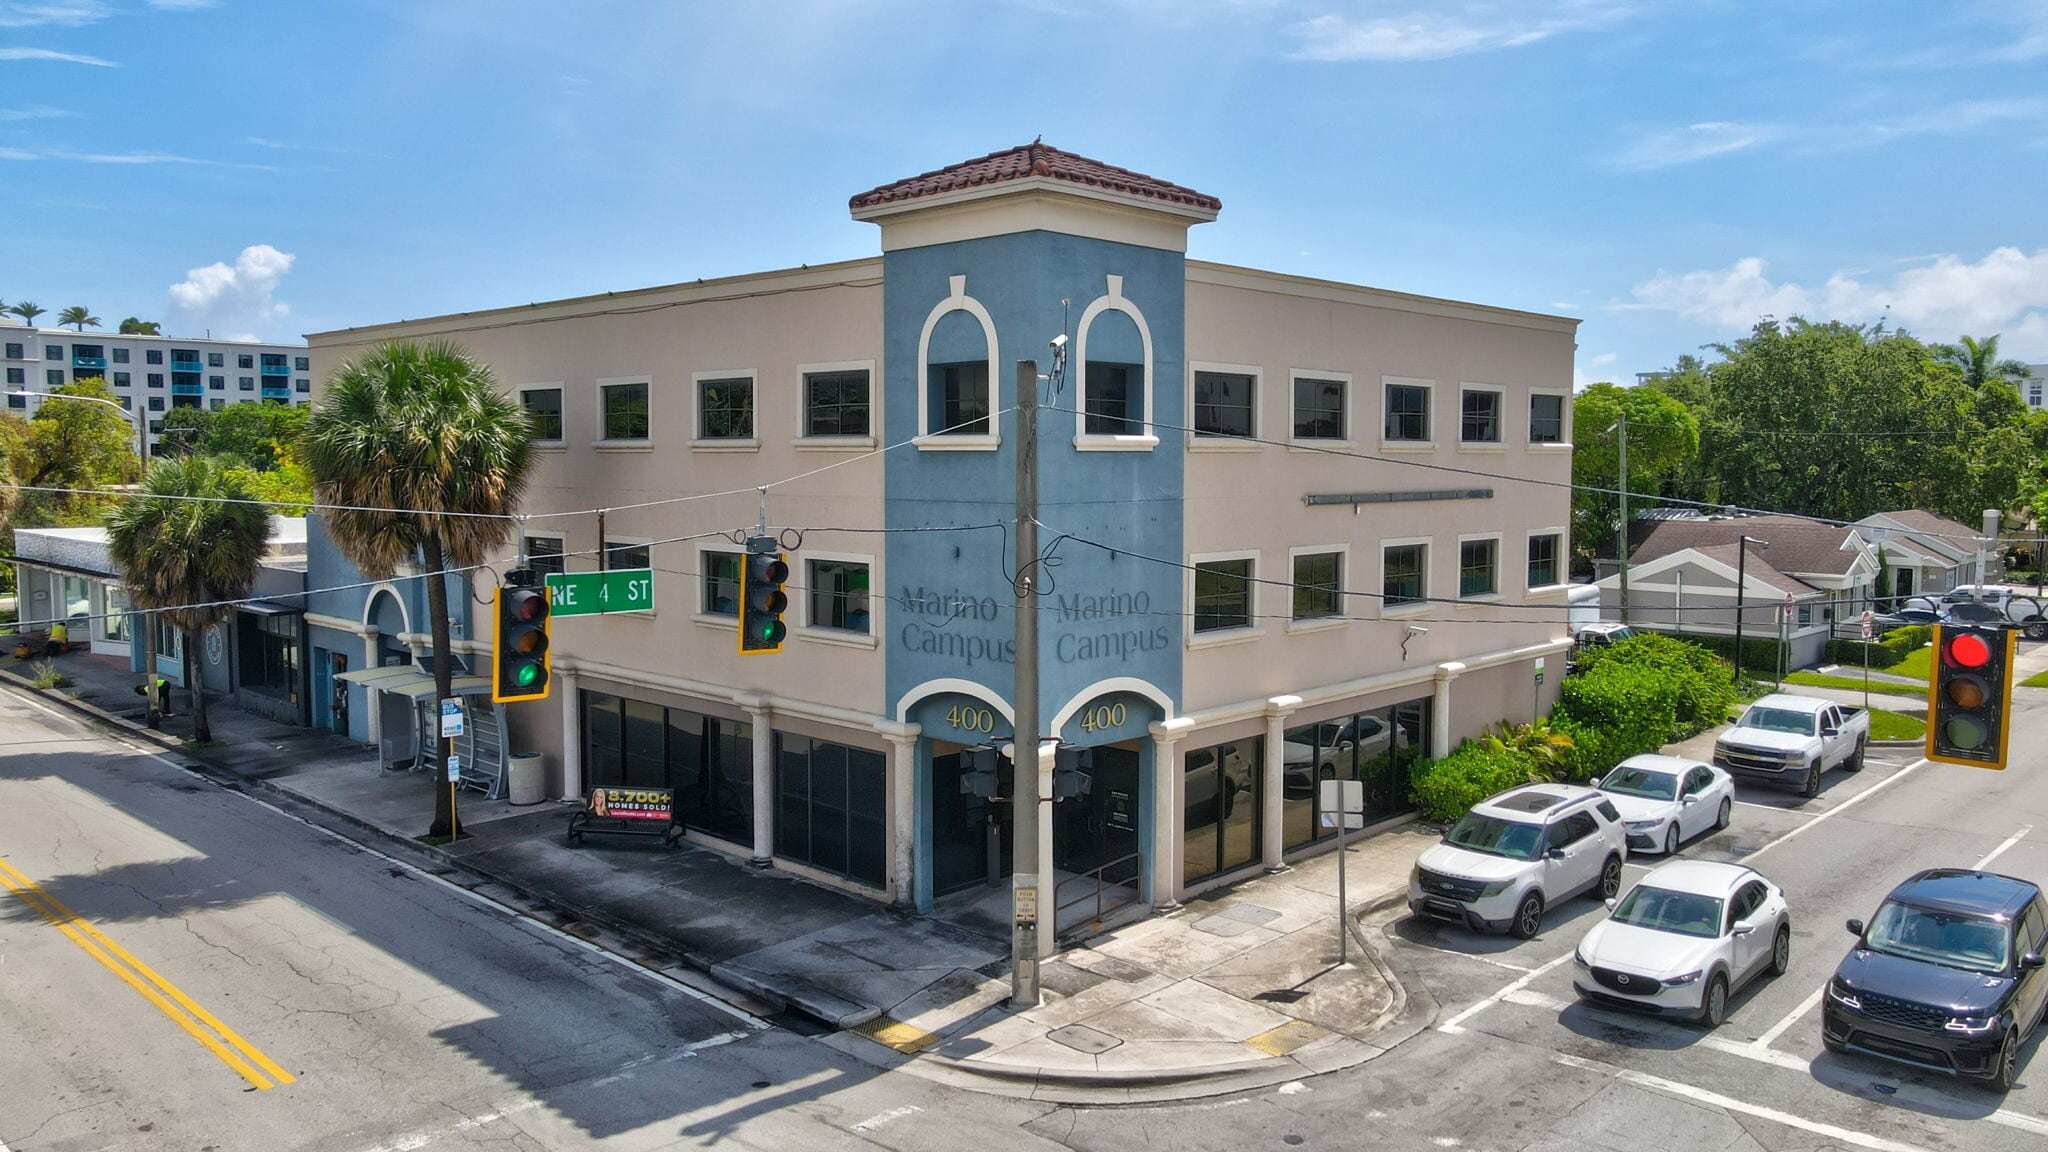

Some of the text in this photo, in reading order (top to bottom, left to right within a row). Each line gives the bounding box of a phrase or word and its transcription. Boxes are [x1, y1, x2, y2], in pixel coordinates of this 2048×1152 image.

[552, 580, 649, 606] NE 4 ST
[901, 584, 998, 622] Marino
[1056, 587, 1151, 624] Marino
[901, 622, 1016, 666] Campus
[1056, 625, 1170, 664] Campus
[442, 708, 458, 716] STOP
[946, 704, 995, 734] 400
[1081, 702, 1127, 733] 400
[608, 802, 670, 811] HOMES SOLD!
